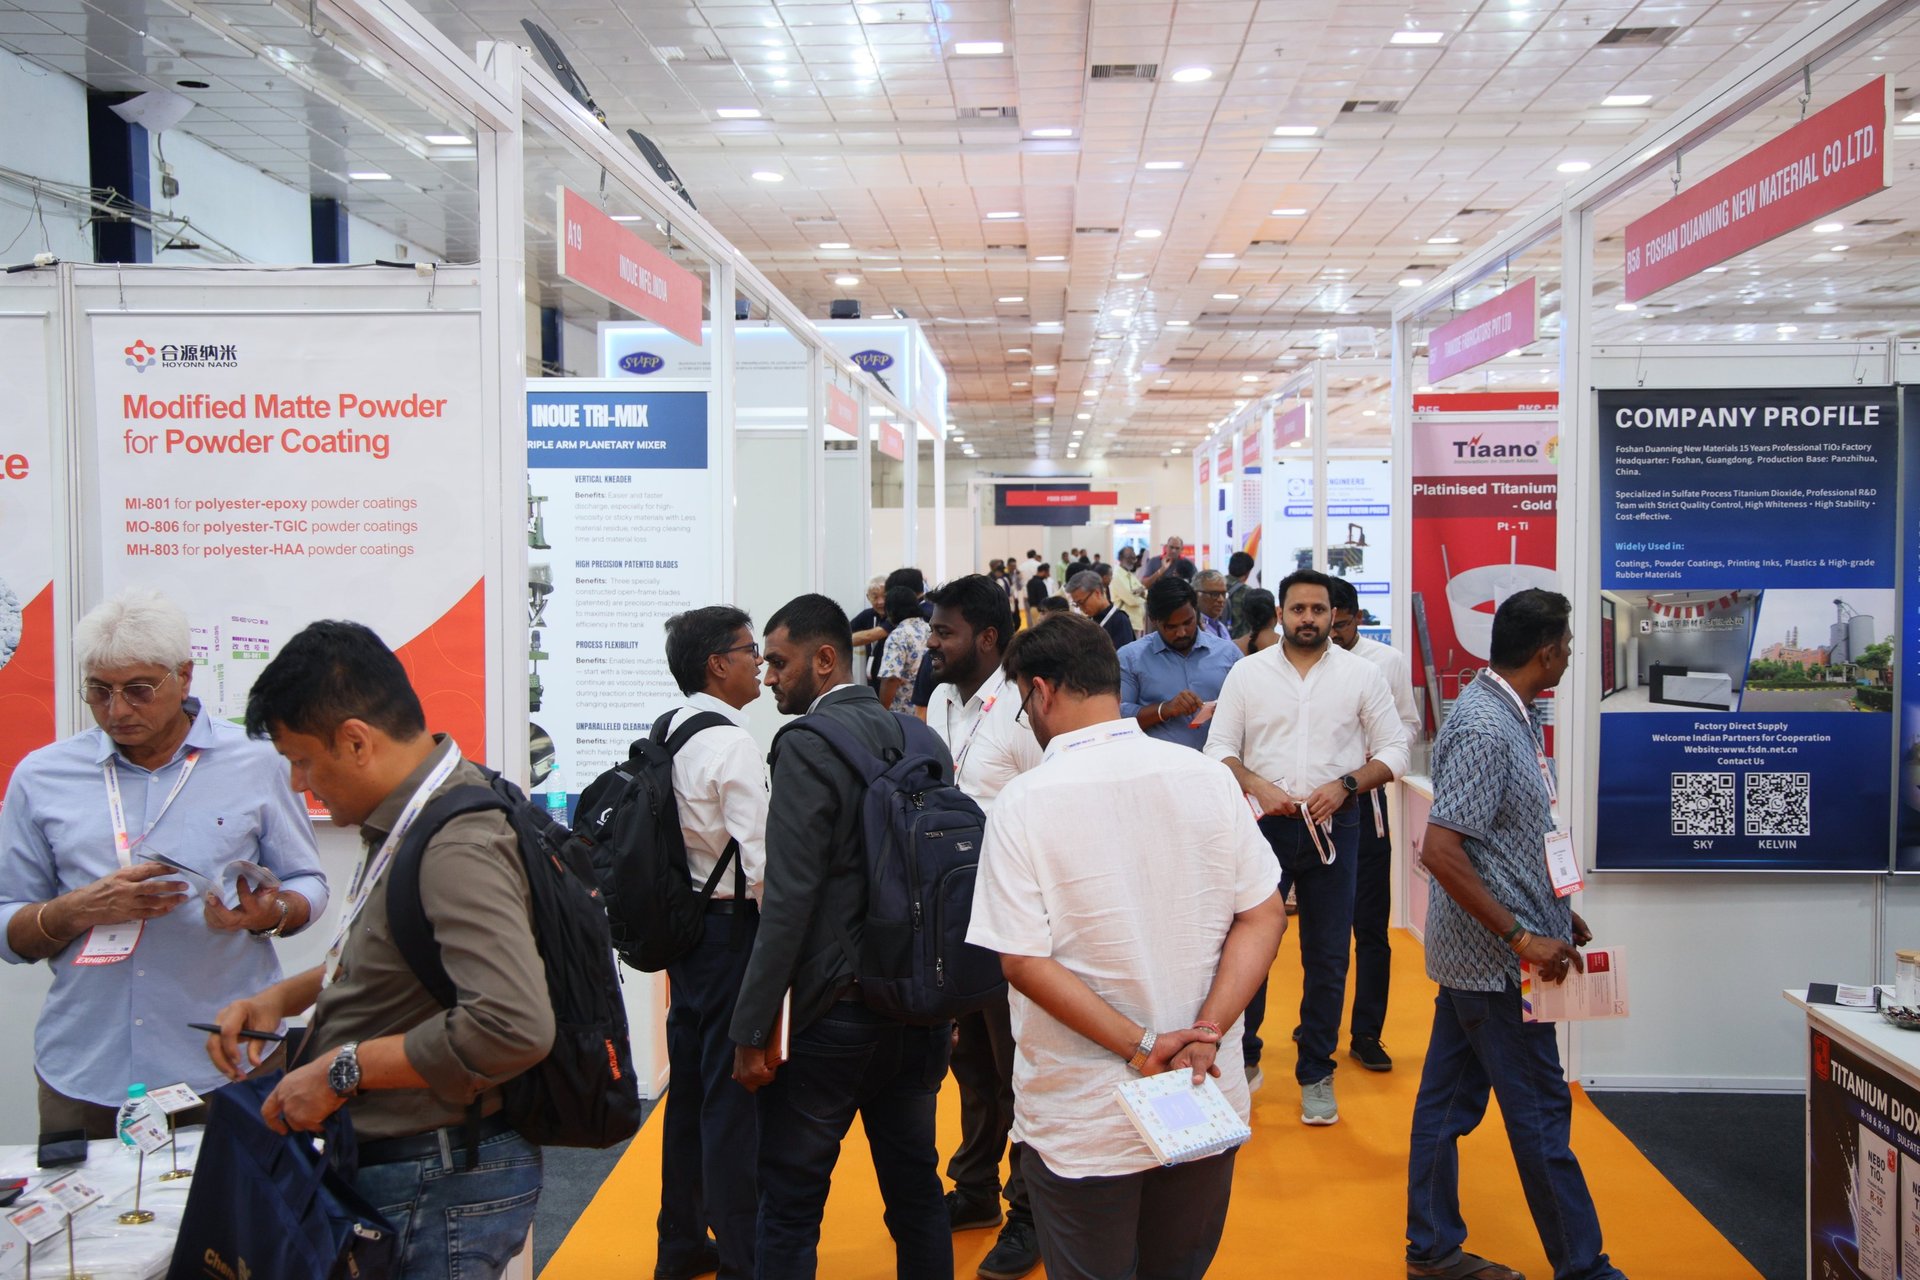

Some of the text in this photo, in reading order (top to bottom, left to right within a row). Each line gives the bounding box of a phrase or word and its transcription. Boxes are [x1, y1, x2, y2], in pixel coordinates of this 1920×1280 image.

[1626, 246, 1641, 275] B58
[1645, 228, 1678, 267] FOSHAN
[1680, 200, 1729, 247] DUANNING
[1732, 183, 1756, 222] NEW
[1758, 153, 1819, 209] MATERIAL
[568, 219, 582, 251] A19
[161, 344, 238, 361] 合源纳米
[124, 393, 448, 419] Modified Matte Powder
[532, 404, 648, 428] INOUE TRI-MIX
[1616, 405, 1880, 428] COMPANY PROFILE
[124, 428, 390, 460] for Powder Coating
[527, 440, 666, 450] RIPLE ARM PLANETARY MIXER
[1453, 433, 1538, 458] Tiaano
[1645, 445, 1682, 454] Duanning
[1702, 444, 1738, 452] Materials
[1740, 444, 1750, 452] 15
[1750, 444, 1770, 452] Years
[1772, 443, 1822, 451] Professional
[1842, 443, 1872, 452] Factory
[1616, 456, 1670, 466] Headquarter:
[1672, 456, 1704, 464] Foshan,
[1758, 456, 1804, 464] Production
[1806, 455, 1829, 463] Base:
[1832, 454, 1878, 463] Panzhihua,
[1616, 468, 1641, 476] China.
[575, 476, 632, 484] VERTICAL KNEADER
[1413, 482, 1556, 496] Platinised Titanium
[1616, 490, 1660, 500] Specialized
[1662, 490, 1670, 498] in
[1672, 490, 1700, 498] Sulfate
[1701, 490, 1732, 498] Process
[1771, 490, 1805, 498] Dioxide,
[1806, 489, 1857, 497] Professional
[126, 497, 418, 512] MI-801 for polyester-epoxy powder coatings
[1520, 500, 1552, 510] Gold
[1680, 502, 1710, 510] Quality
[1711, 501, 1744, 509] Control,
[1745, 500, 1764, 510] High
[1765, 500, 1808, 508] Whiteness
[1814, 500, 1834, 510] High
[1835, 500, 1870, 509] Stability
[1616, 512, 1672, 520] Cost-effective.
[126, 520, 418, 535] MO-806 for polyester-TGIC powder coatings
[1498, 522, 1528, 530] Pt Ti
[126, 543, 414, 558] MH-803 for polyester-HAA powder coatings
[1616, 542, 1685, 552] Widely Used in:
[576, 560, 678, 569] HIGH PRECISION PATENTED BLADES
[1616, 560, 1652, 568] Coatings,
[1688, 560, 1725, 568] Coatings,
[1728, 560, 1760, 568] Printing
[1762, 559, 1782, 568] Inks,
[1828, 559, 1876, 568] High-grade
[1616, 570, 1682, 578] Rubber Materials
[576, 577, 608, 585] Benefits:
[576, 640, 638, 649] PROCESS FLEXIBILITY
[576, 657, 608, 665] Benefits:
[576, 723, 622, 731] UNPARALLELED
[1694, 722, 1788, 732] Factory Direct Supply
[576, 738, 608, 746] Benefits:
[1652, 734, 1831, 744] Welcome Indian Partners for Cooperation
[1684, 745, 1798, 754] Website:www.fsdn.net.cn
[1718, 757, 1765, 765] Contact Us
[1693, 840, 1797, 850] SKY KELVIN
[1830, 1060, 1888, 1116] TITANIUM
[1860, 1109, 1872, 1124] R-18
[1878, 1120, 1890, 1135] R-19
[1868, 1150, 1886, 1172] NEBO
[1870, 1190, 1884, 1208] R-18
